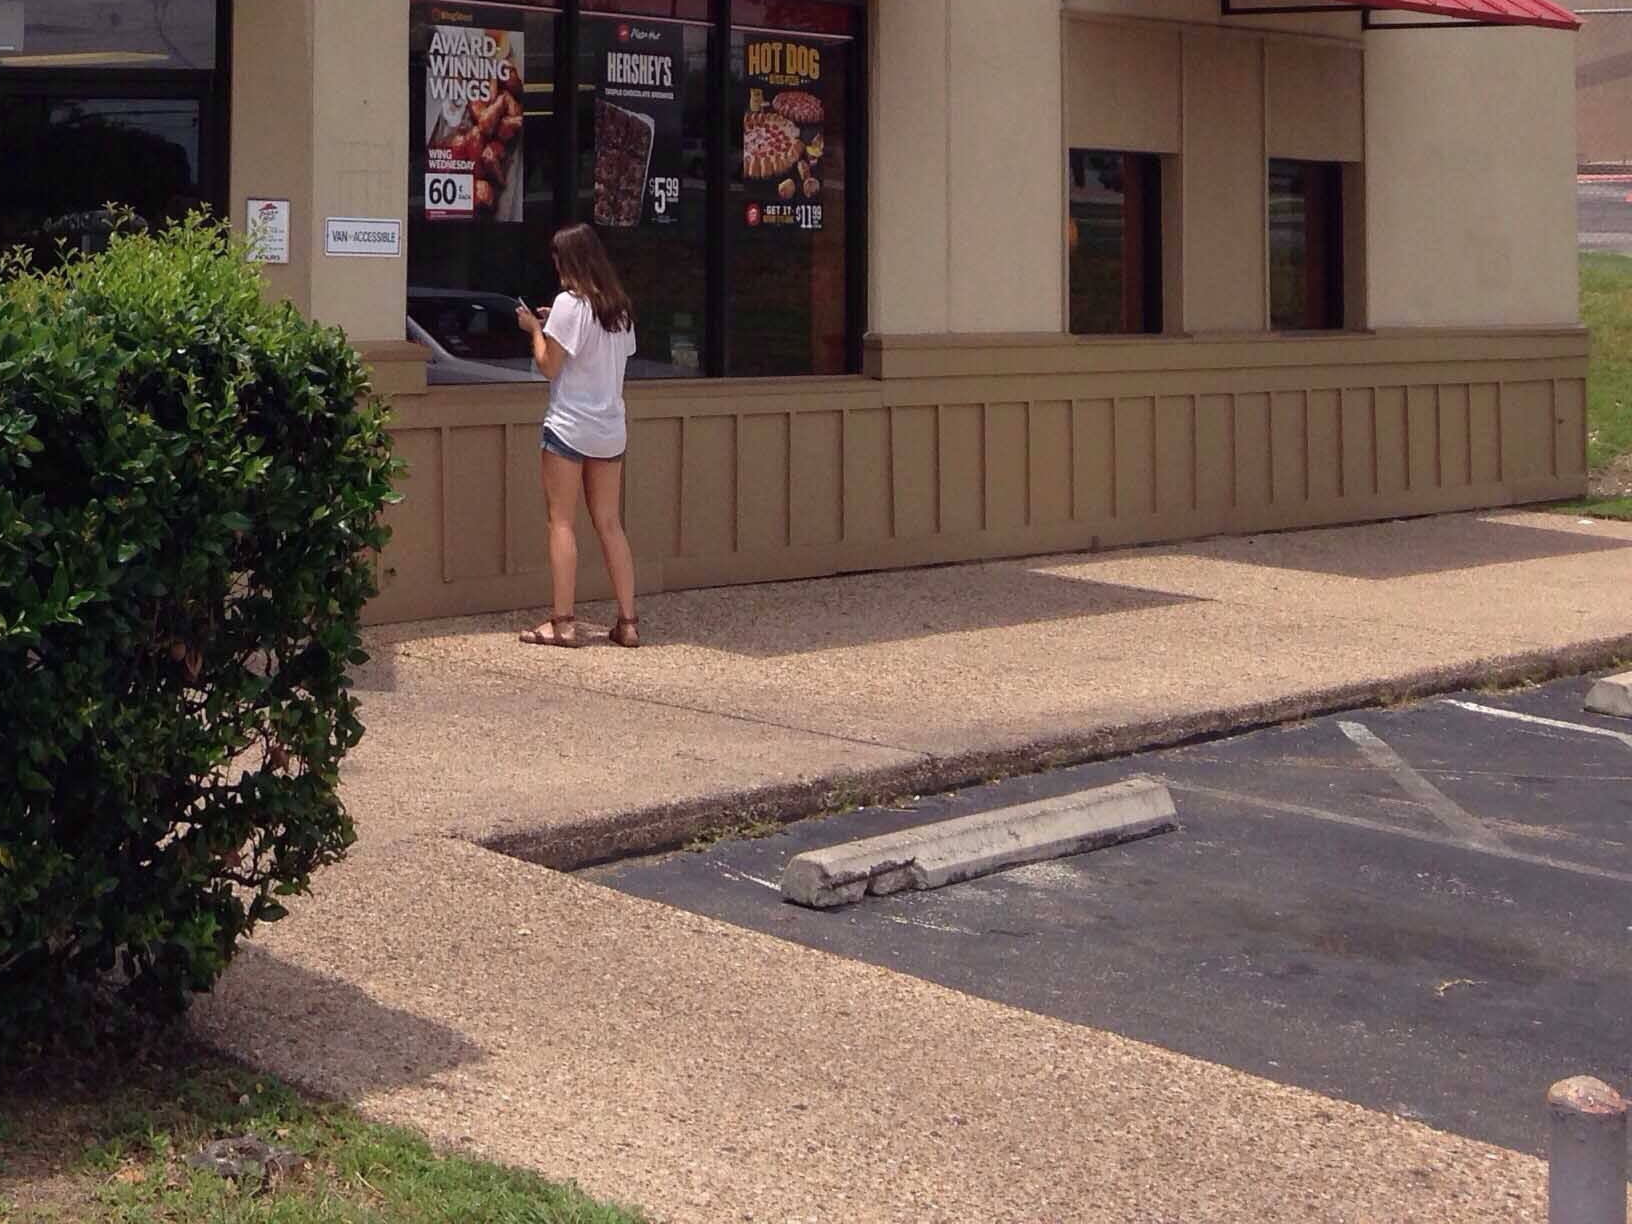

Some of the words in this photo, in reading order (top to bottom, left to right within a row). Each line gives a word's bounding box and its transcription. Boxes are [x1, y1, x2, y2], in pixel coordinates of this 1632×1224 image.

[429, 54, 513, 82] WINNING
[607, 51, 673, 87] HERSHEY'S
[749, 41, 784, 76] HOT
[786, 42, 821, 81] DOG
[429, 77, 492, 103] WINGS
[428, 148, 453, 160] WING
[428, 159, 476, 171] WEDNESDAY
[429, 178, 457, 205] 60
[332, 230, 348, 242] VAN
[353, 230, 397, 244] ACCESSIBLE
